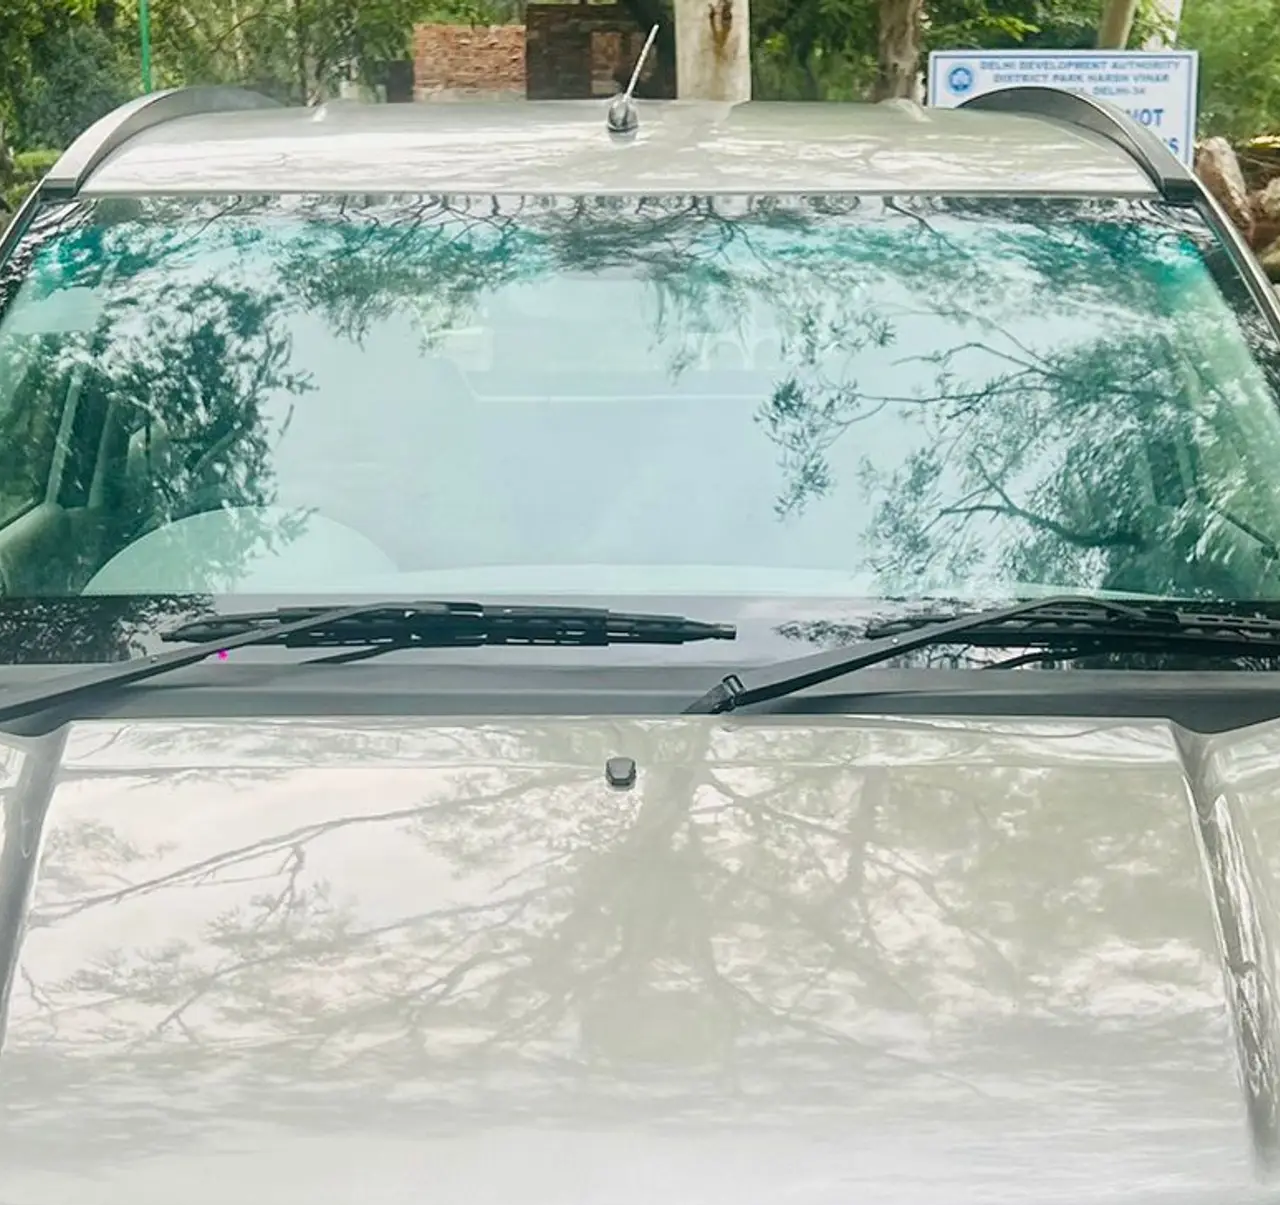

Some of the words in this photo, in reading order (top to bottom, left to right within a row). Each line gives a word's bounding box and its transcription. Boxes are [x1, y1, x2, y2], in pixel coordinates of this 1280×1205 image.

[980, 60, 1016, 70] DELHI
[1021, 60, 1107, 70] DEVELOPMENT
[1111, 60, 1179, 70] AUTHORITY
[993, 73, 1048, 83] DISTRICT
[1052, 73, 1084, 83] PARK
